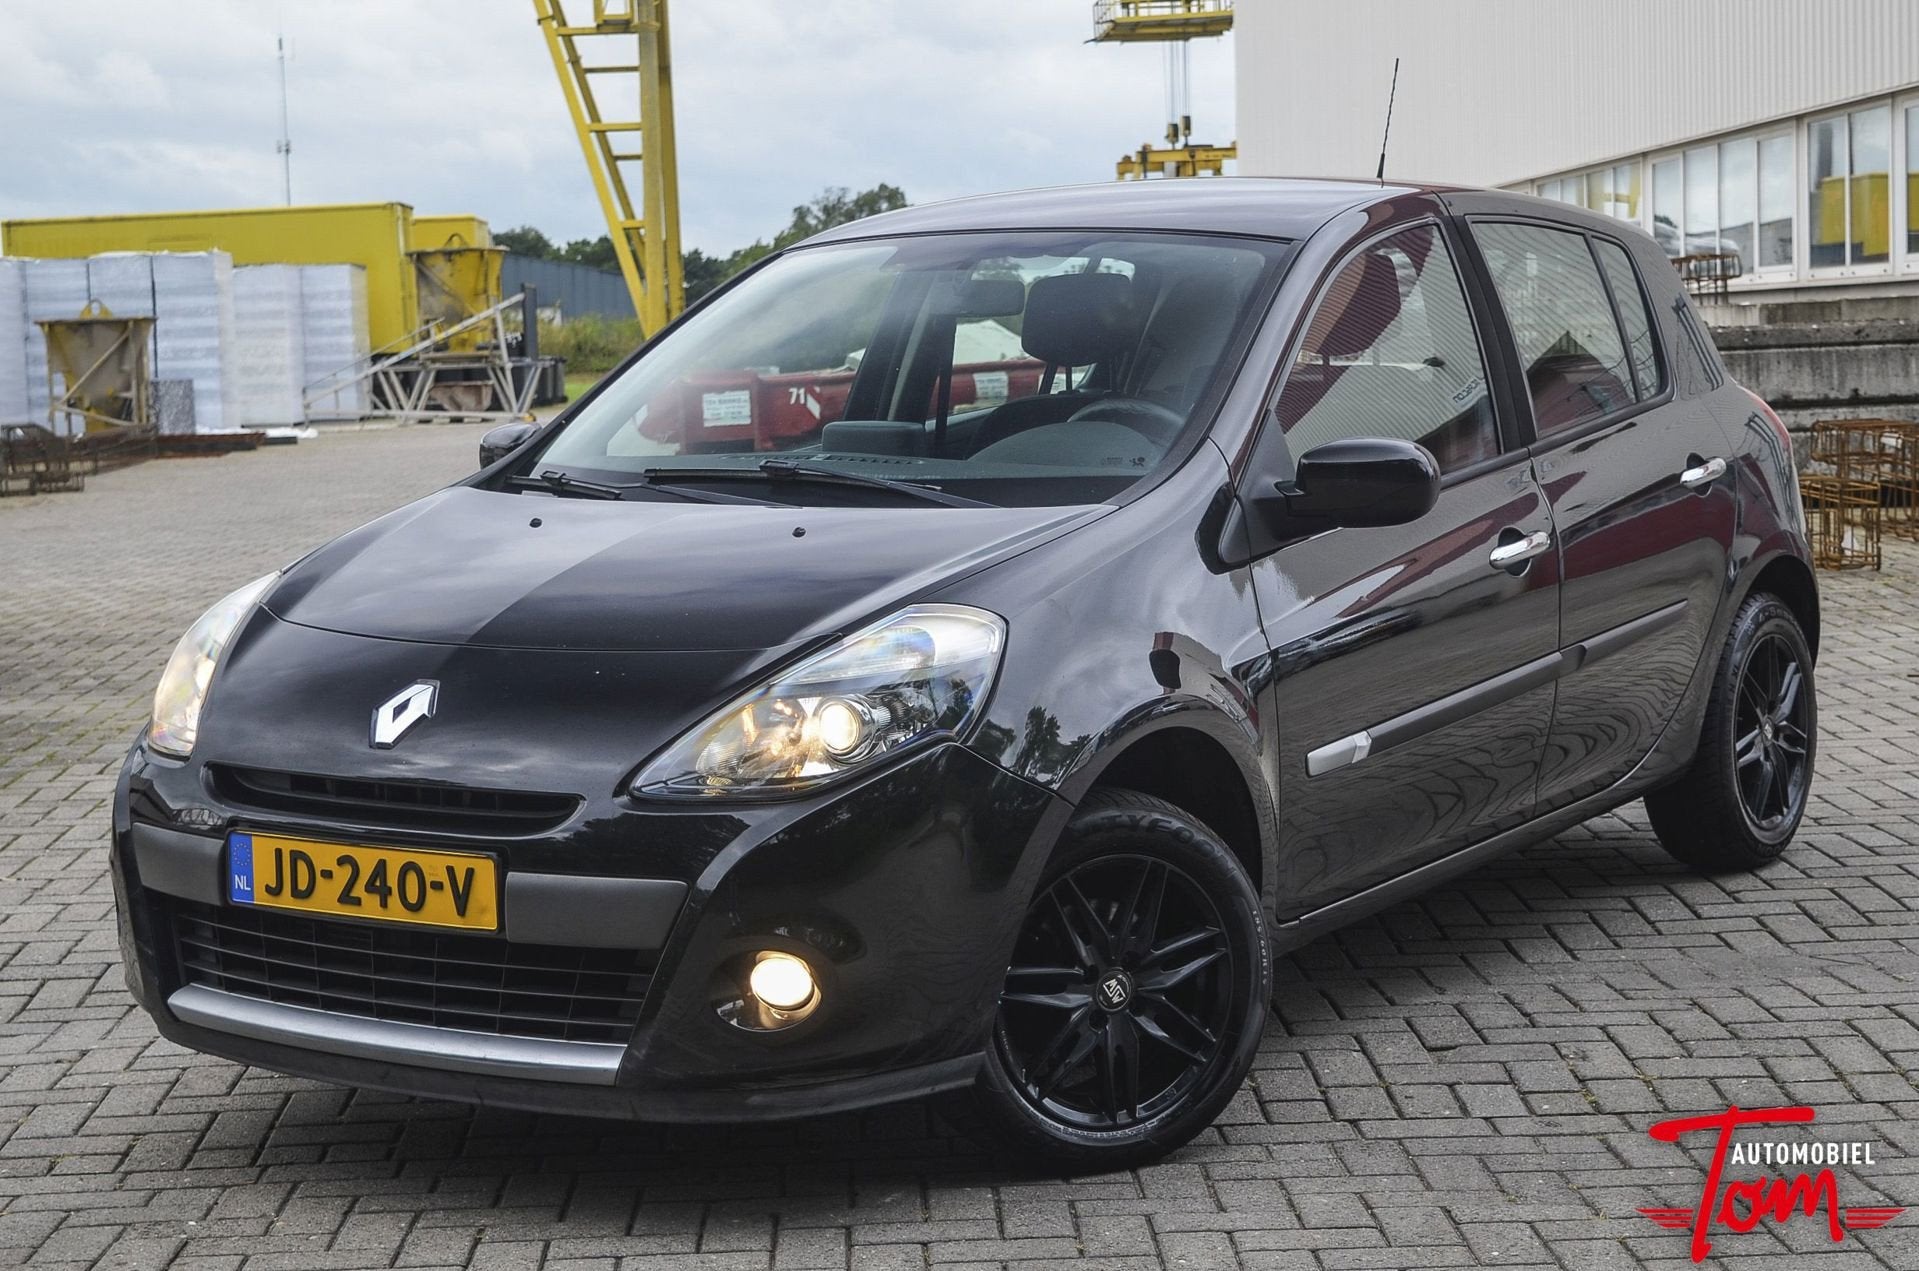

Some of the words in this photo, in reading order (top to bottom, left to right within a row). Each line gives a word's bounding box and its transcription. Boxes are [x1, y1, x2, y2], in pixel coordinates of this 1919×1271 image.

[788, 387, 805, 405] 71
[234, 874, 251, 891] NL
[264, 847, 475, 917] JD-240-V
